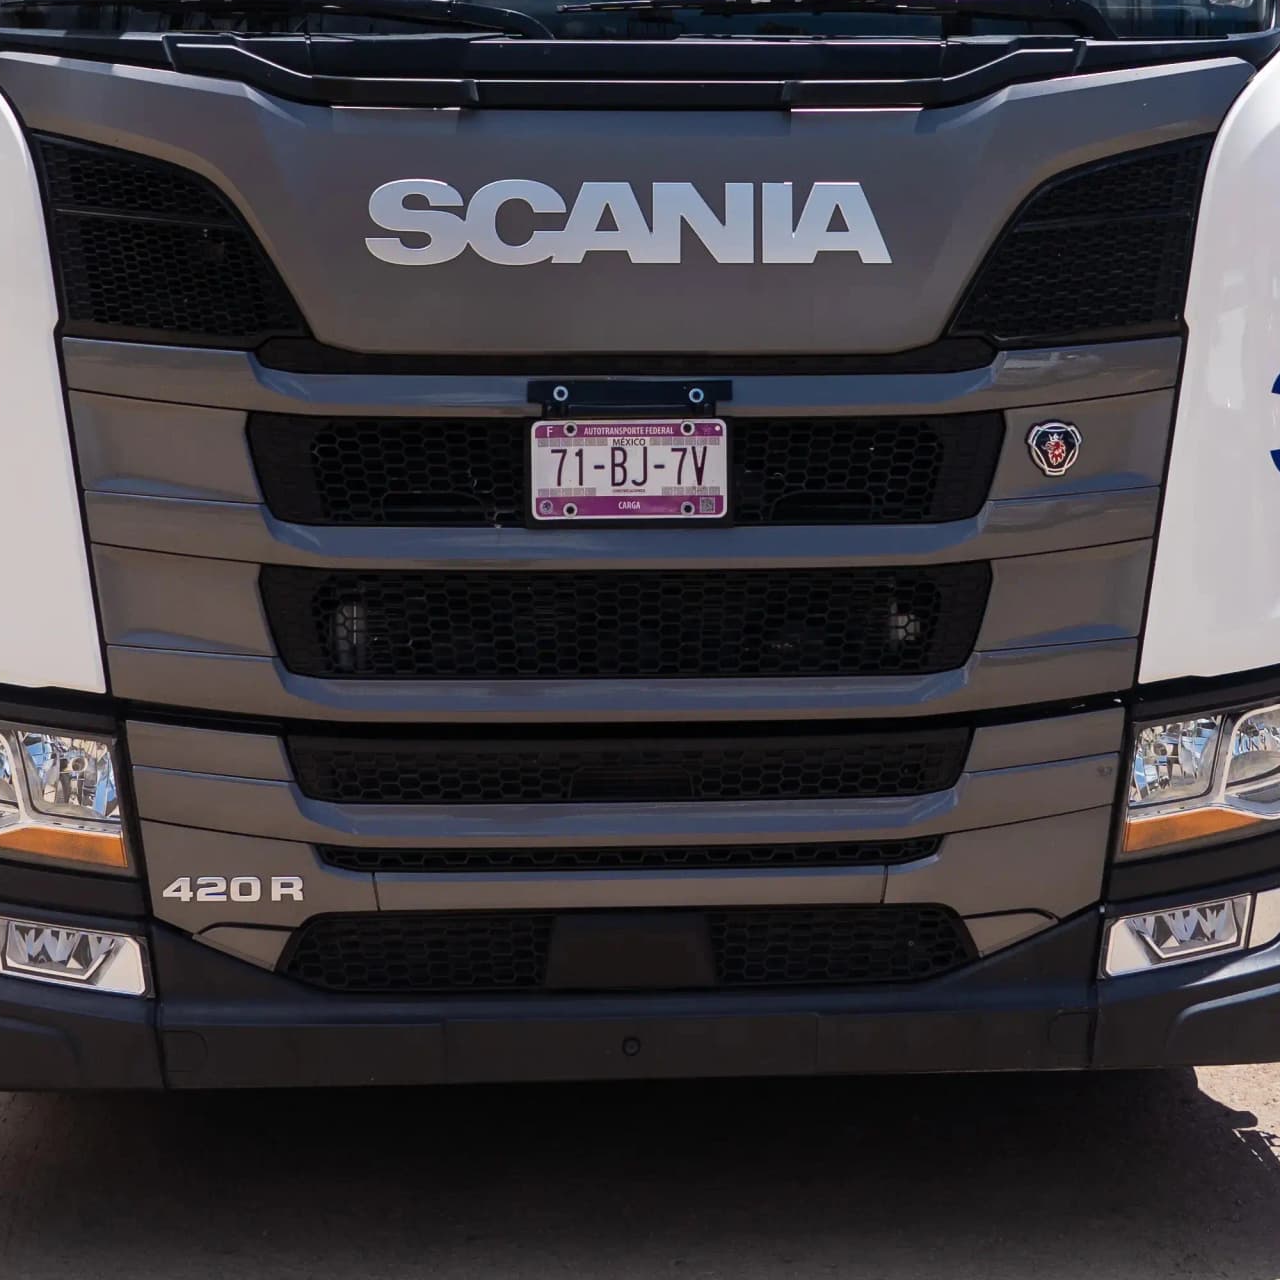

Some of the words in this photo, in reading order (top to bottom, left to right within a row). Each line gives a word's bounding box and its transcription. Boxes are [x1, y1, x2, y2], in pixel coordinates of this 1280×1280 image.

[364, 178, 893, 266] SCANIA
[546, 426, 553, 438] F
[583, 426, 644, 436] AUTOTRANSPORTE
[645, 426, 675, 435] FEDERAL
[612, 436, 646, 446] MÉXICO
[550, 446, 708, 488] 71-BJ-7V
[618, 501, 641, 510] CARGA
[161, 875, 261, 903] 420
[270, 875, 305, 902] R
